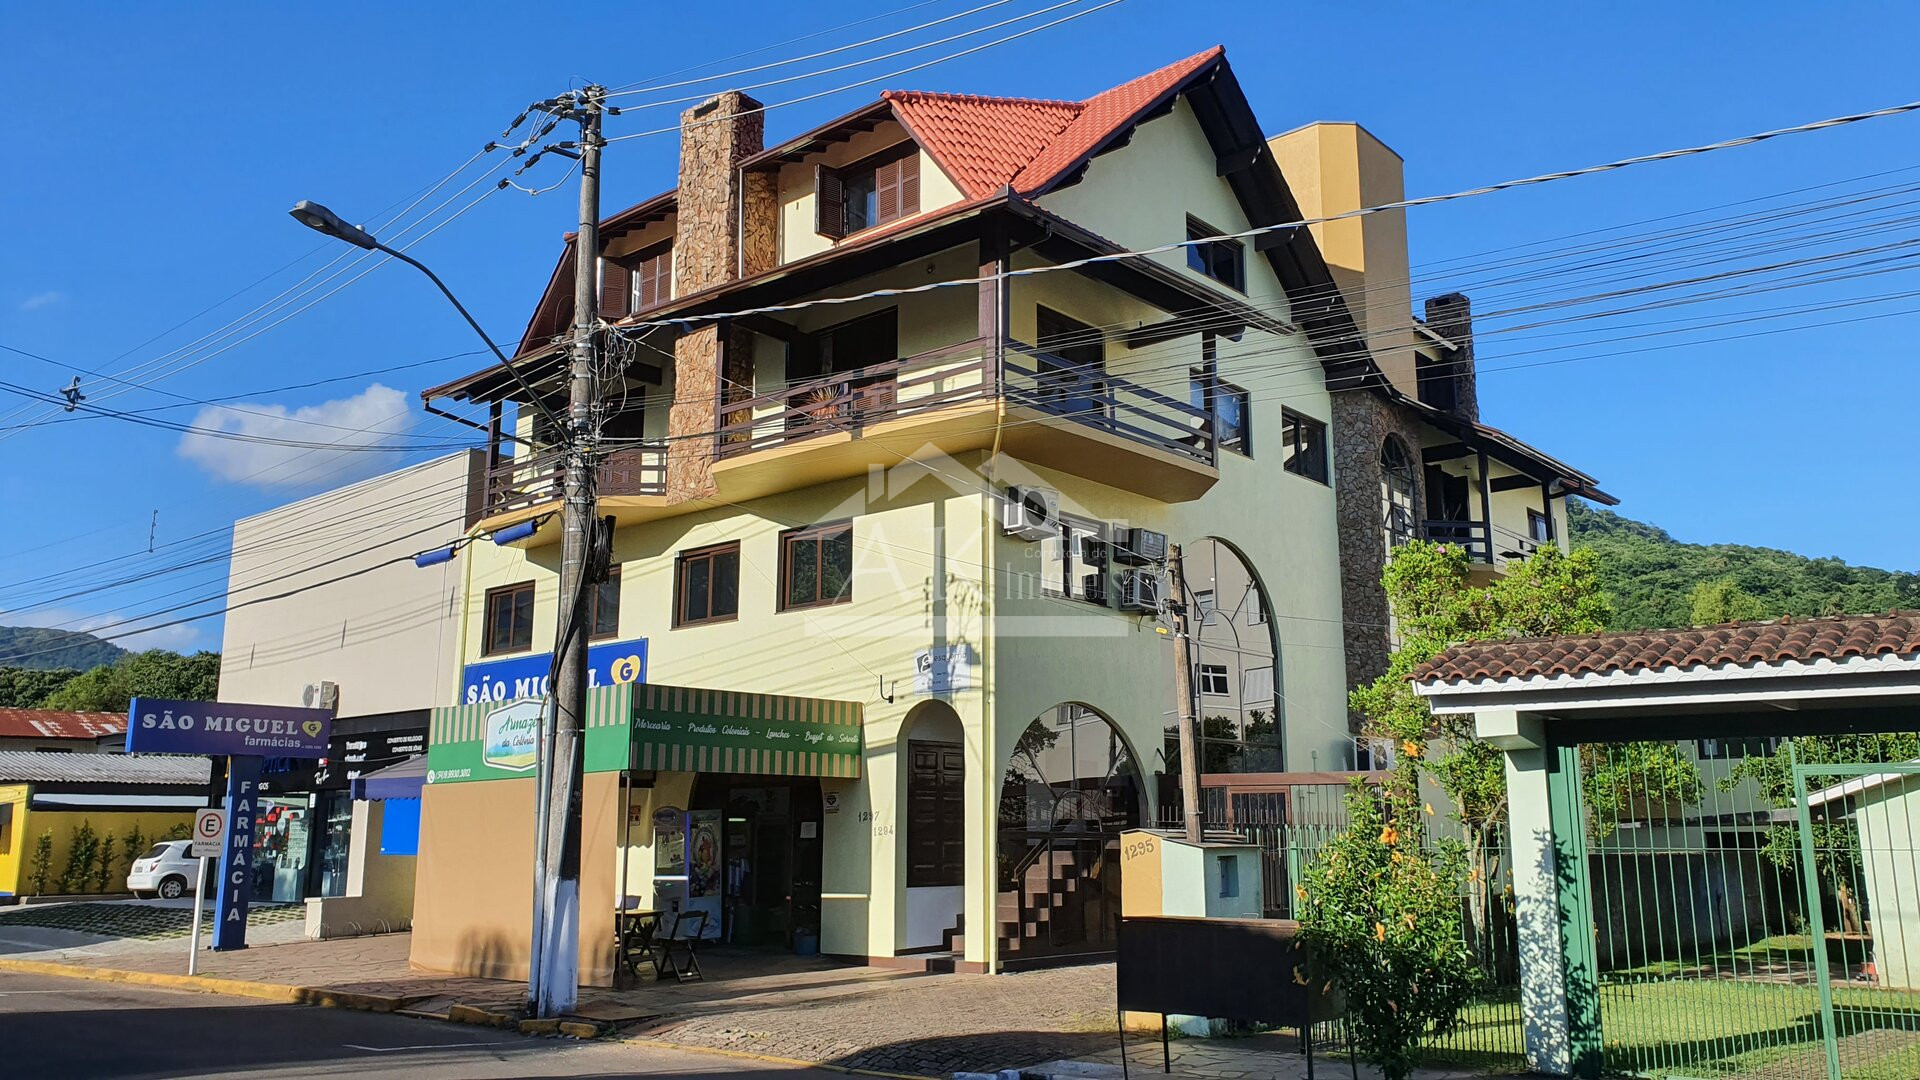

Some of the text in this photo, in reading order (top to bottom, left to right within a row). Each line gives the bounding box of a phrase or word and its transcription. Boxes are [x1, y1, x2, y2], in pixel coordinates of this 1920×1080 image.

[619, 662, 633, 679] G
[467, 675, 506, 704] SÃO
[142, 710, 298, 735] SÃO MIGUEL
[634, 718, 671, 731] Mercearia
[687, 722, 717, 734] Produtos
[721, 724, 751, 736] Coloniais
[766, 728, 790, 739] Lanches
[244, 735, 301, 748] farmácias
[501, 737, 510, 748] da
[205, 818, 216, 832] E
[227, 781, 251, 921] FARMÁCIA
[1124, 837, 1154, 861] 1295
